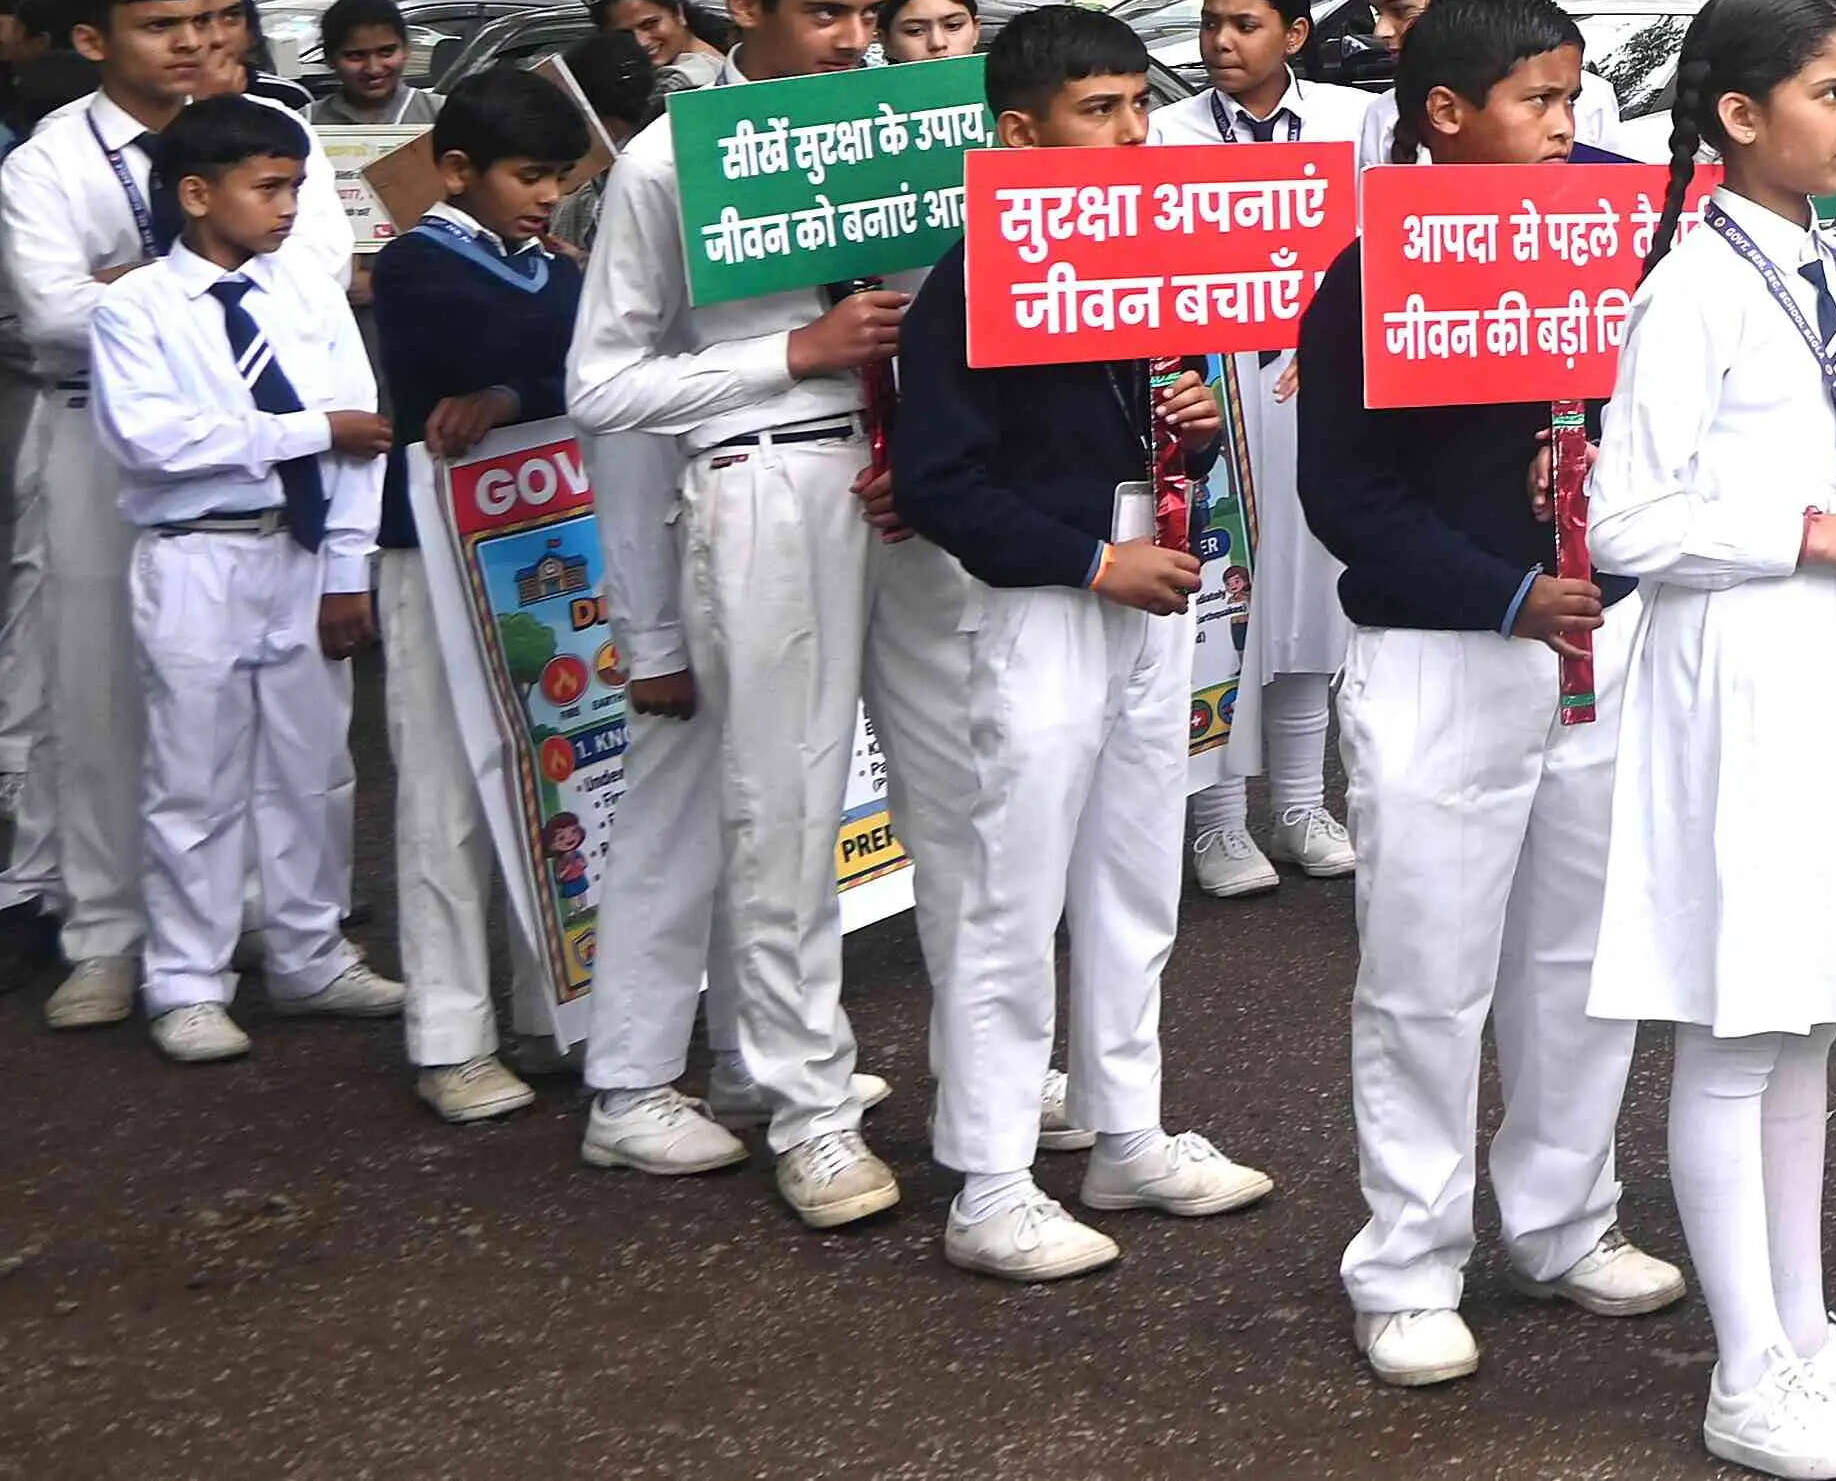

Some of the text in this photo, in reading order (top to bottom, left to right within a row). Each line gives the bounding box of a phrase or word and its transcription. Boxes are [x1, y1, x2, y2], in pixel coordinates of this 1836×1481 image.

[717, 116, 790, 180] सीखें
[788, 114, 873, 185] सुरक्षा
[873, 103, 910, 156] के
[701, 205, 791, 267] जीवन
[790, 194, 838, 251] को
[838, 181, 918, 243] बनाएं
[995, 161, 1329, 263] सुरक्षा अपनाएं
[1402, 213, 1500, 264] आपदा
[1510, 198, 1541, 262] से
[1544, 198, 1621, 267] पहले
[1010, 246, 1304, 334] जीवन बचाएँ
[1383, 294, 1480, 360] जीवन
[1483, 290, 1530, 358] की
[1533, 289, 1589, 370] बड़ी
